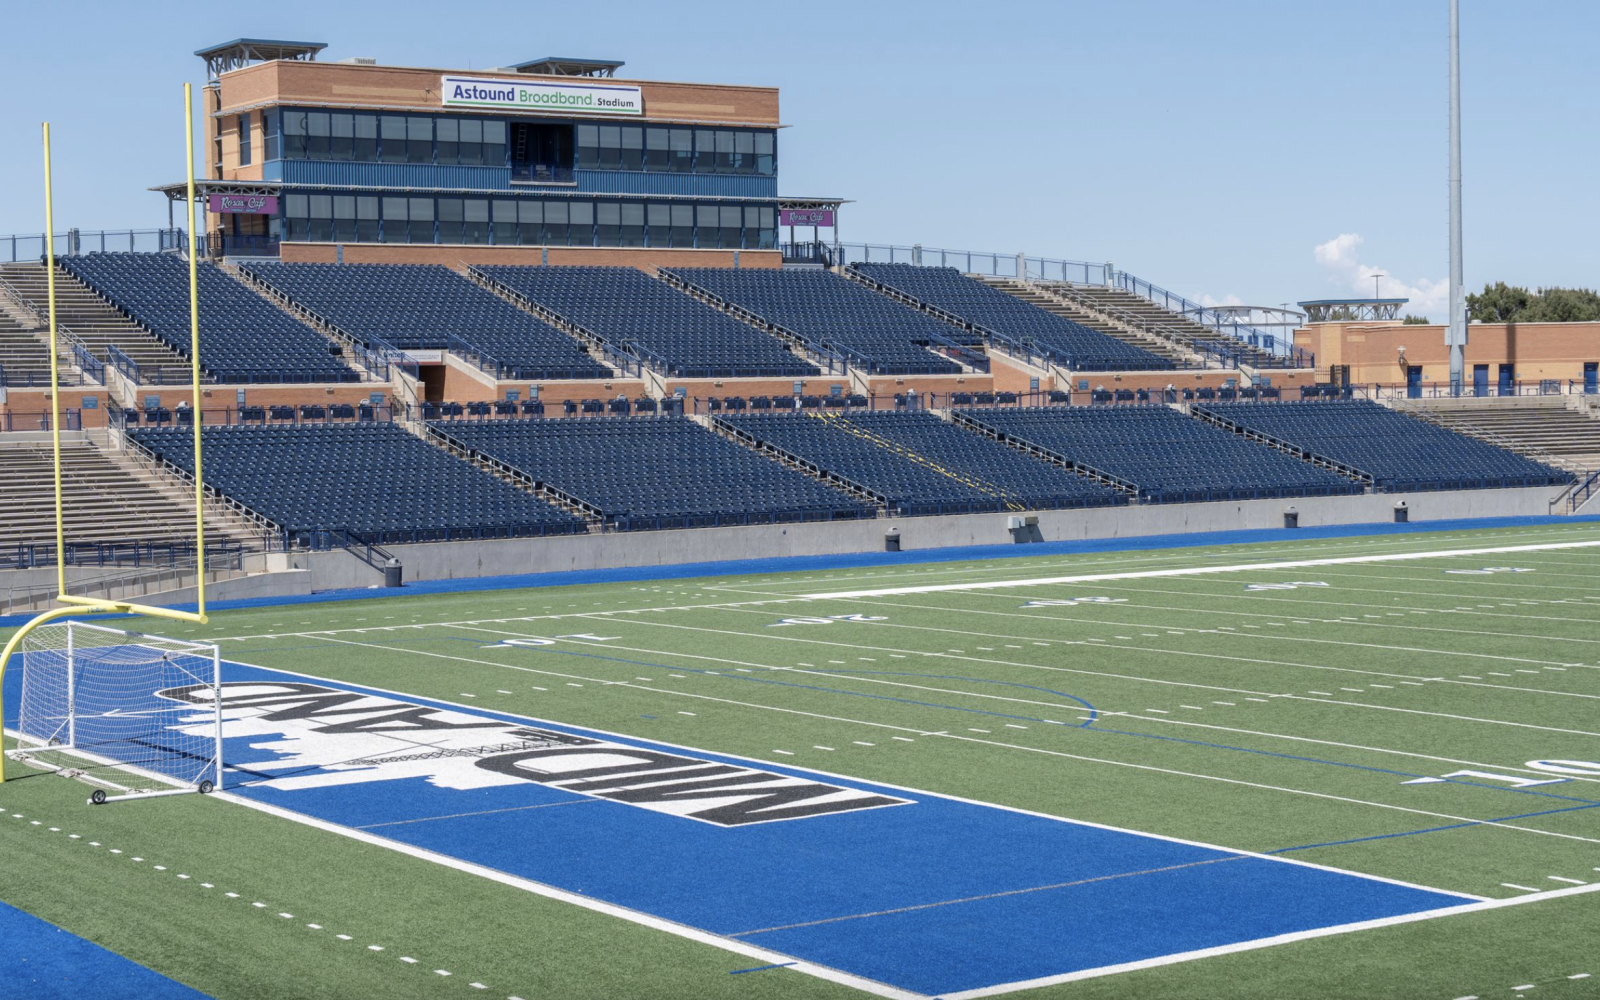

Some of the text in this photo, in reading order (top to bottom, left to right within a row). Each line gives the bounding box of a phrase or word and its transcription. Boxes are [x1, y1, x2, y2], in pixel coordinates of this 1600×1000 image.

[453, 85, 634, 108] Astound Broadband Stadium
